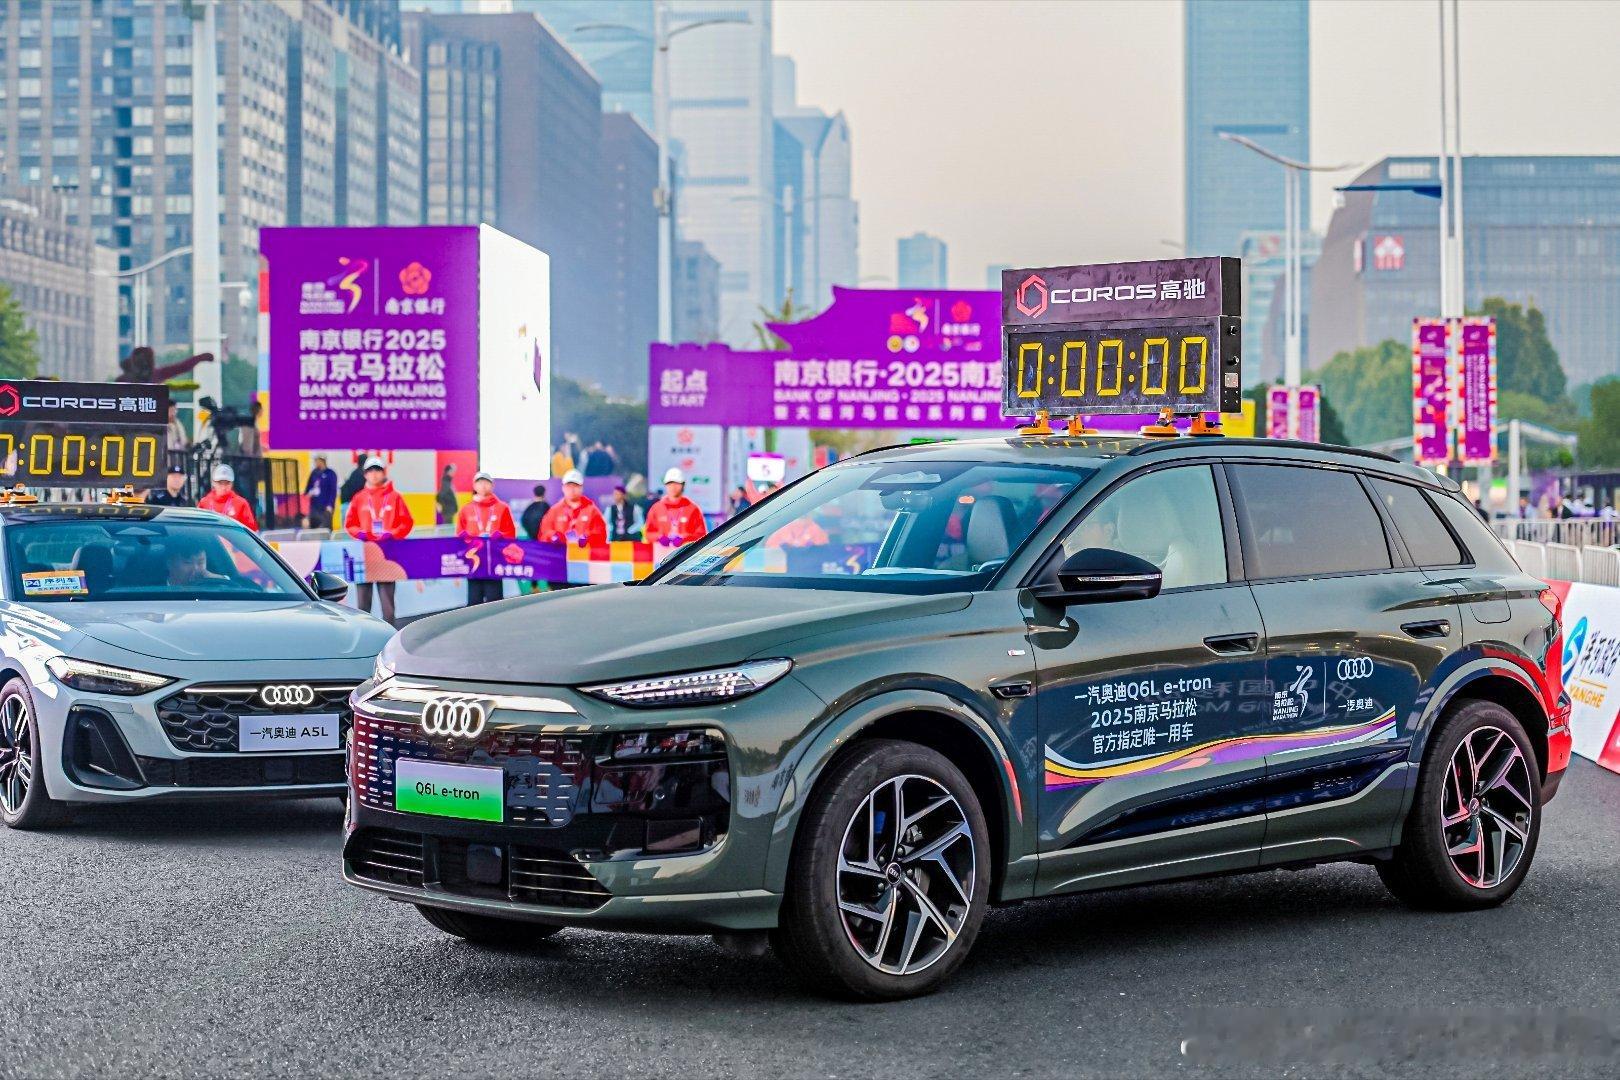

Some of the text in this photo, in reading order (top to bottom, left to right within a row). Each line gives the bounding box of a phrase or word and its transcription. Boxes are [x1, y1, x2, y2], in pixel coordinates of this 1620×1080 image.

[299, 351, 446, 382] 南京马拉松
[299, 383, 447, 397] BANK OF NANJING
[660, 393, 706, 407] START
[1163, 677, 1212, 695] e-tron
[1090, 697, 1198, 729] 2025南京马拉松
[250, 726, 329, 740] 一汽奥迪 A5L
[1092, 722, 1194, 755] 官方指定唯一用车
[415, 781, 480, 800] Q6L e-tron
